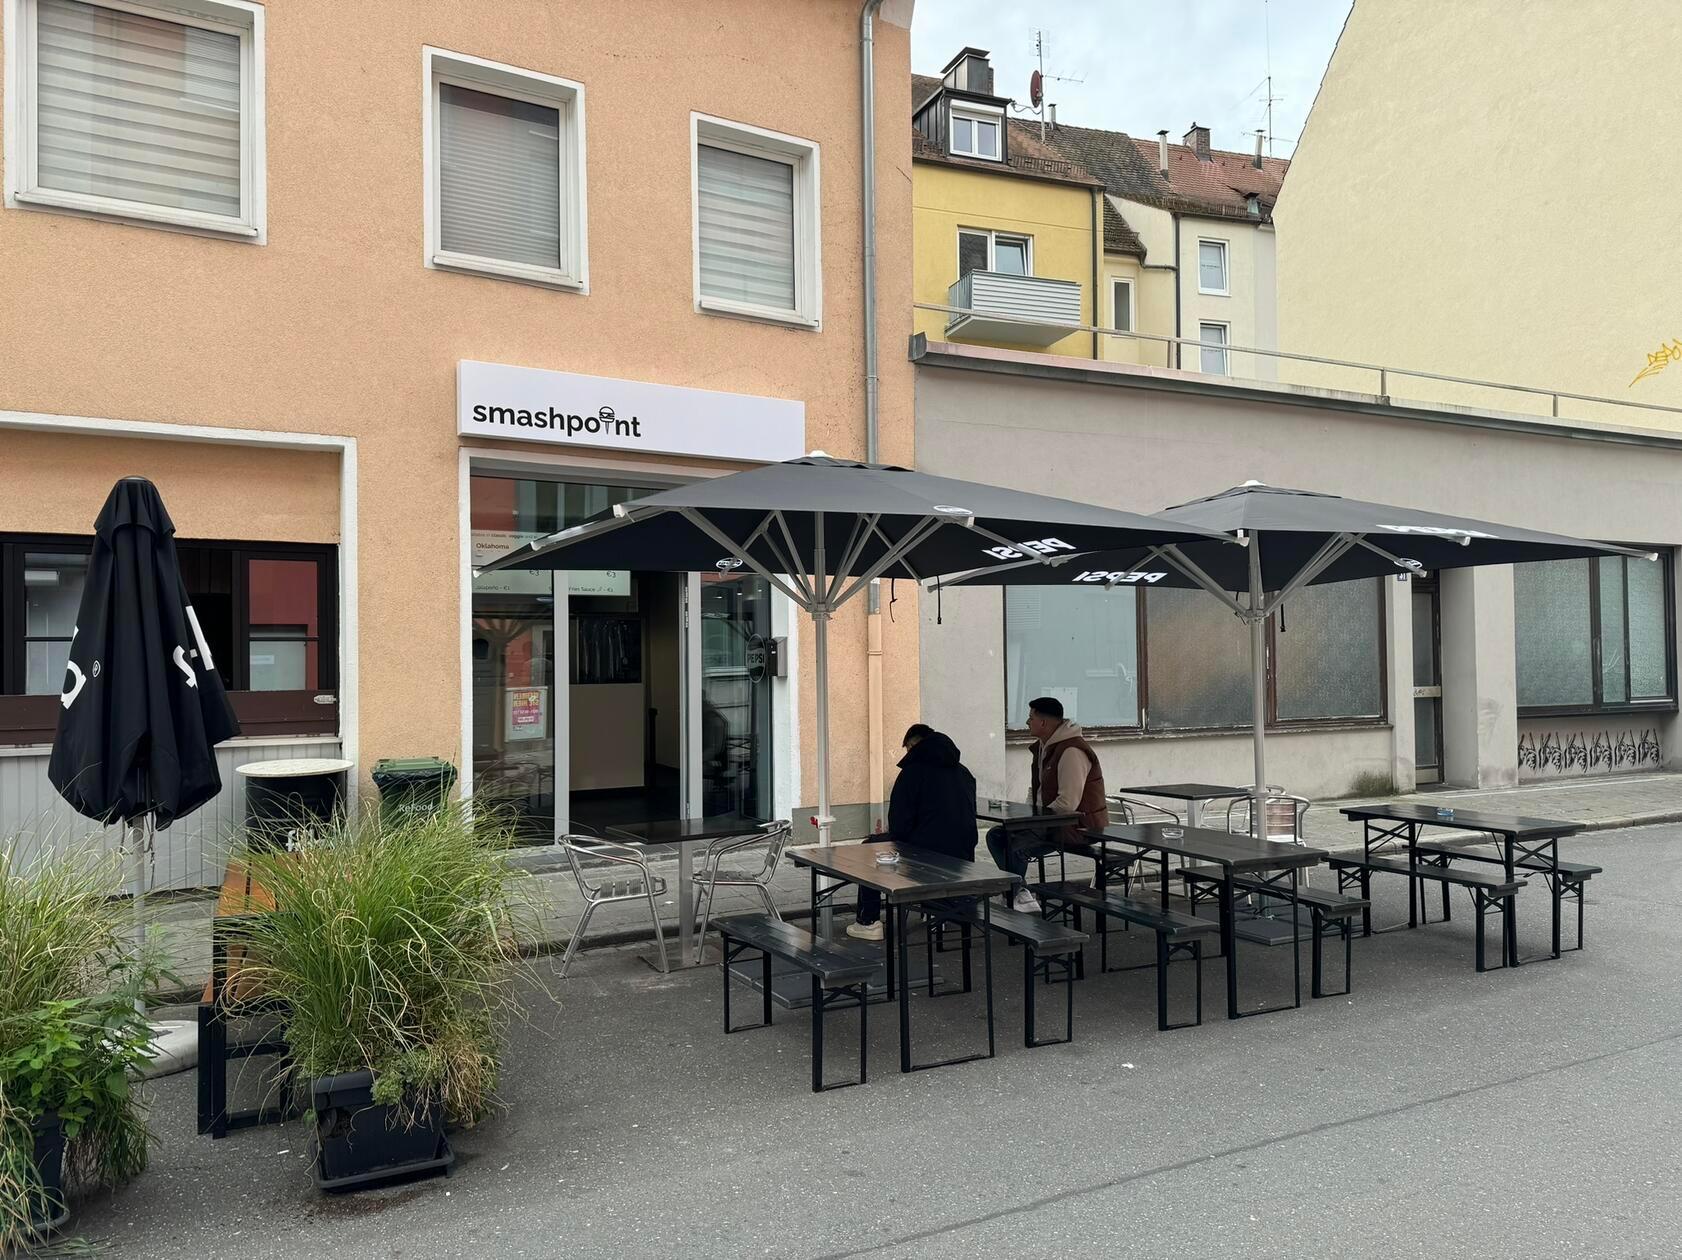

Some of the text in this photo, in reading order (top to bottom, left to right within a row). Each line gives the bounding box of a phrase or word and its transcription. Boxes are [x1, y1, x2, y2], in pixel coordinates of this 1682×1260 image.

[472, 404, 642, 437] smashpoint
[475, 542, 510, 550] Oklahoma
[747, 653, 765, 663] PEPSI
